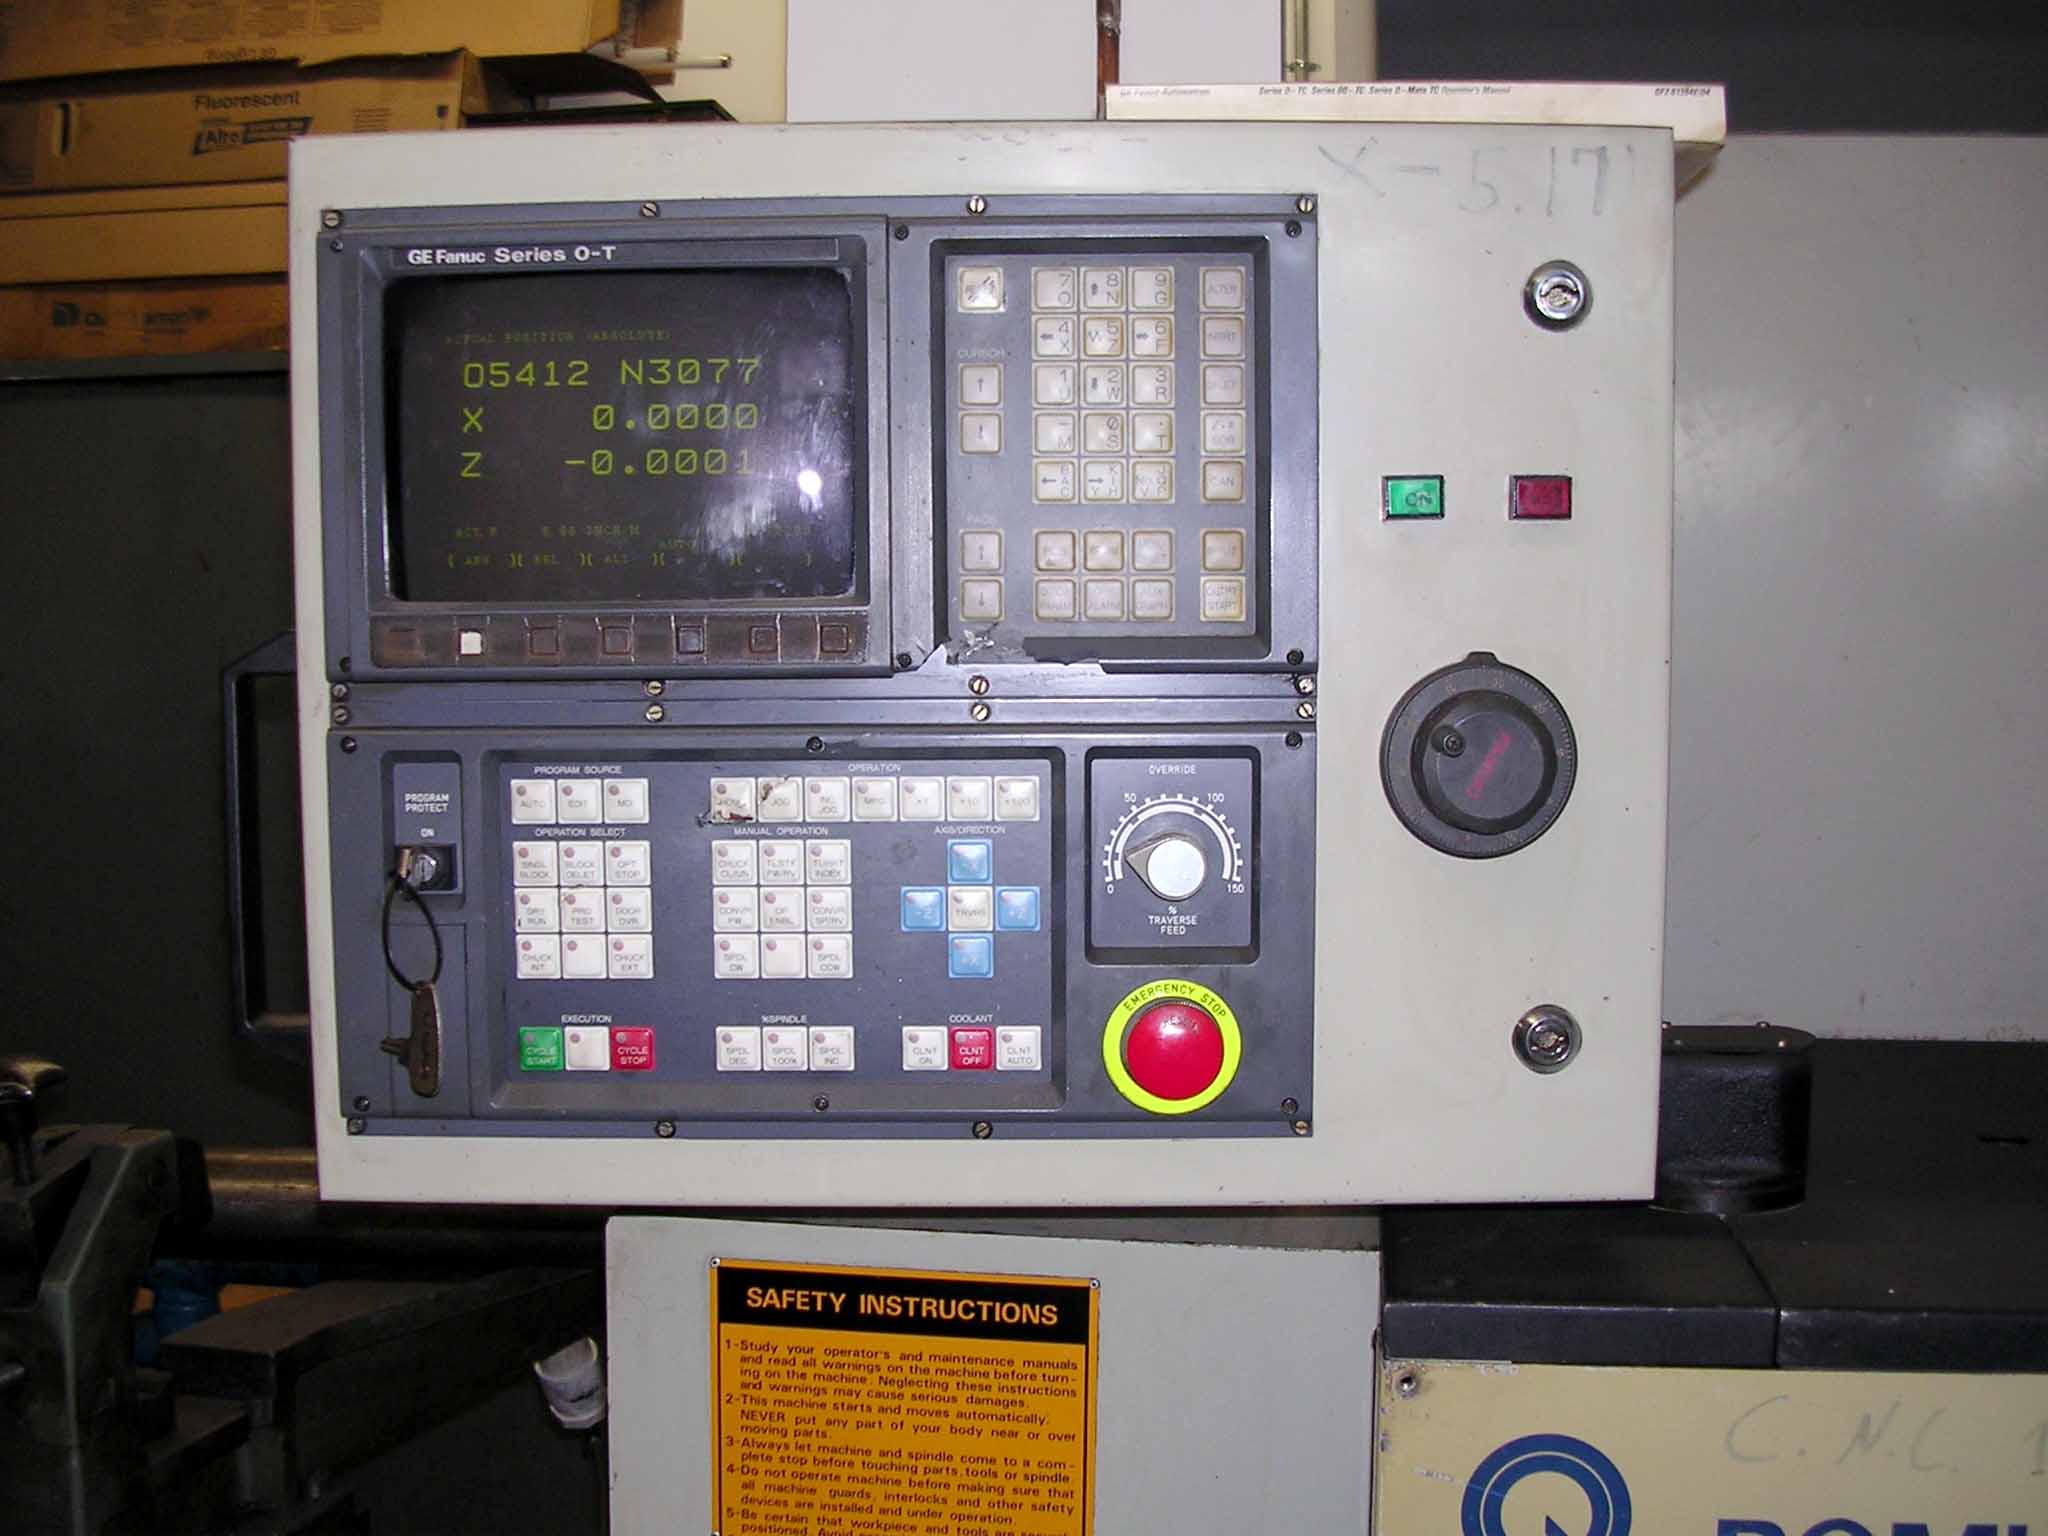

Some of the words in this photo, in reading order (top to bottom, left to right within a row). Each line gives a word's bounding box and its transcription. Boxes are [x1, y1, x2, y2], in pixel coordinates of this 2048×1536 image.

[194, 91, 301, 110] Fluorescent
[1317, 137, 1386, 197] X
[408, 249, 433, 264] GE
[436, 249, 486, 264] Fanuc
[494, 246, 566, 264] Series
[1058, 273, 1071, 287] 7
[1106, 273, 1119, 287] 8
[1155, 273, 1167, 287] 9
[1106, 292, 1119, 304] N
[1155, 291, 1168, 304] G
[1058, 321, 1070, 334] 4
[1106, 321, 1119, 334] 5
[1155, 321, 1168, 335] 6
[1059, 340, 1070, 352] X
[620, 358, 760, 385] N3077
[1059, 369, 1067, 382] 1
[1107, 369, 1120, 383] 2
[1155, 369, 1168, 382] 3
[1106, 387, 1120, 400] W
[1155, 387, 1168, 400] R
[463, 407, 484, 433] X
[592, 404, 758, 430] 0.0000
[1106, 435, 1119, 449] S
[1155, 435, 1168, 448] T
[460, 452, 482, 478] Z
[533, 766, 580, 774] PROGRAM
[584, 766, 622, 774] SOURCE
[848, 763, 902, 773] OPERATION
[1148, 765, 1197, 774] OVERRIDE
[404, 793, 450, 803] PROGRAM
[1124, 793, 1137, 802] 50
[1207, 793, 1224, 802] 100
[404, 803, 449, 813] PROTECT
[420, 828, 434, 837] ON
[535, 828, 586, 837] OPERATION
[590, 828, 626, 837] SELECT
[734, 826, 772, 836] MANUAL
[777, 826, 828, 836] OPERATION
[935, 825, 1006, 835] AXIS/DIRECTION
[1107, 884, 1114, 893] 0
[1227, 884, 1244, 893] 150
[1168, 906, 1177, 914] %
[1148, 916, 1197, 925] TRAVERSE
[1160, 926, 1186, 935] FEED
[1123, 983, 1196, 1011] EMERGENCY
[1200, 993, 1227, 1017] STOP
[561, 1014, 612, 1023] EXECUTION
[761, 1014, 807, 1023] %SPINDLE
[949, 1014, 993, 1023] COOLANT
[526, 1047, 556, 1056] CYCLE
[617, 1046, 649, 1055] CYCLE
[725, 1047, 750, 1055] SPDL
[772, 1047, 796, 1055] SPDL
[819, 1047, 842, 1055] SPDL
[959, 1046, 985, 1055] CLNT
[527, 1056, 558, 1065] START
[620, 1056, 647, 1065] STOP
[728, 1057, 748, 1065] DEC
[824, 1057, 841, 1065] INC
[918, 1057, 934, 1065] ON
[962, 1056, 982, 1065] OFF
[1007, 1056, 1033, 1065] AUTO
[746, 1287, 846, 1314] SAFETY
[859, 1294, 1058, 1327] INSTRUCTIONS
[787, 1344, 814, 1356] your
[824, 1345, 890, 1361] operator's
[900, 1350, 922, 1361] and
[929, 1352, 1014, 1367] maintenance
[1023, 1358, 1077, 1372] manuals
[740, 1353, 762, 1364] and
[769, 1355, 796, 1366] read
[802, 1357, 816, 1368] all
[823, 1358, 881, 1374] warnings
[888, 1365, 903, 1374] on
[910, 1364, 930, 1375] the
[936, 1366, 989, 1379] machine
[994, 1370, 1036, 1383] before
[740, 1366, 759, 1379] ing
[765, 1370, 780, 1379] on
[787, 1369, 806, 1380] the
[879, 1376, 948, 1392] Neglecting
[956, 1381, 992, 1393] these
[998, 1384, 1076, 1399] instructions
[741, 1379, 762, 1390] and
[770, 1381, 827, 1397] warnings
[834, 1388, 861, 1399] may
[867, 1390, 904, 1400] cause
[912, 1391, 957, 1404] serious
[774, 1397, 826, 1410] machine
[834, 1401, 872, 1413] starts
[878, 1404, 901, 1415] and
[907, 1408, 949, 1418] moves
[741, 1410, 784, 1422] NEVER
[795, 1413, 816, 1427] put
[826, 1418, 848, 1429] any
[856, 1418, 882, 1431] part
[891, 1420, 904, 1430] of
[913, 1423, 940, 1435] your
[950, 1424, 982, 1438] body
[992, 1429, 1018, 1438] near
[1028, 1431, 1040, 1440] or
[1048, 1433, 1075, 1442] over
[741, 1423, 787, 1438] moving
[796, 1442, 810, 1453] let
[818, 1443, 871, 1457] machine
[879, 1448, 902, 1459] and
[908, 1450, 953, 1465] spindle
[961, 1455, 996, 1465] come
[1004, 1456, 1016, 1467] to
[1023, 1459, 1030, 1467] a
